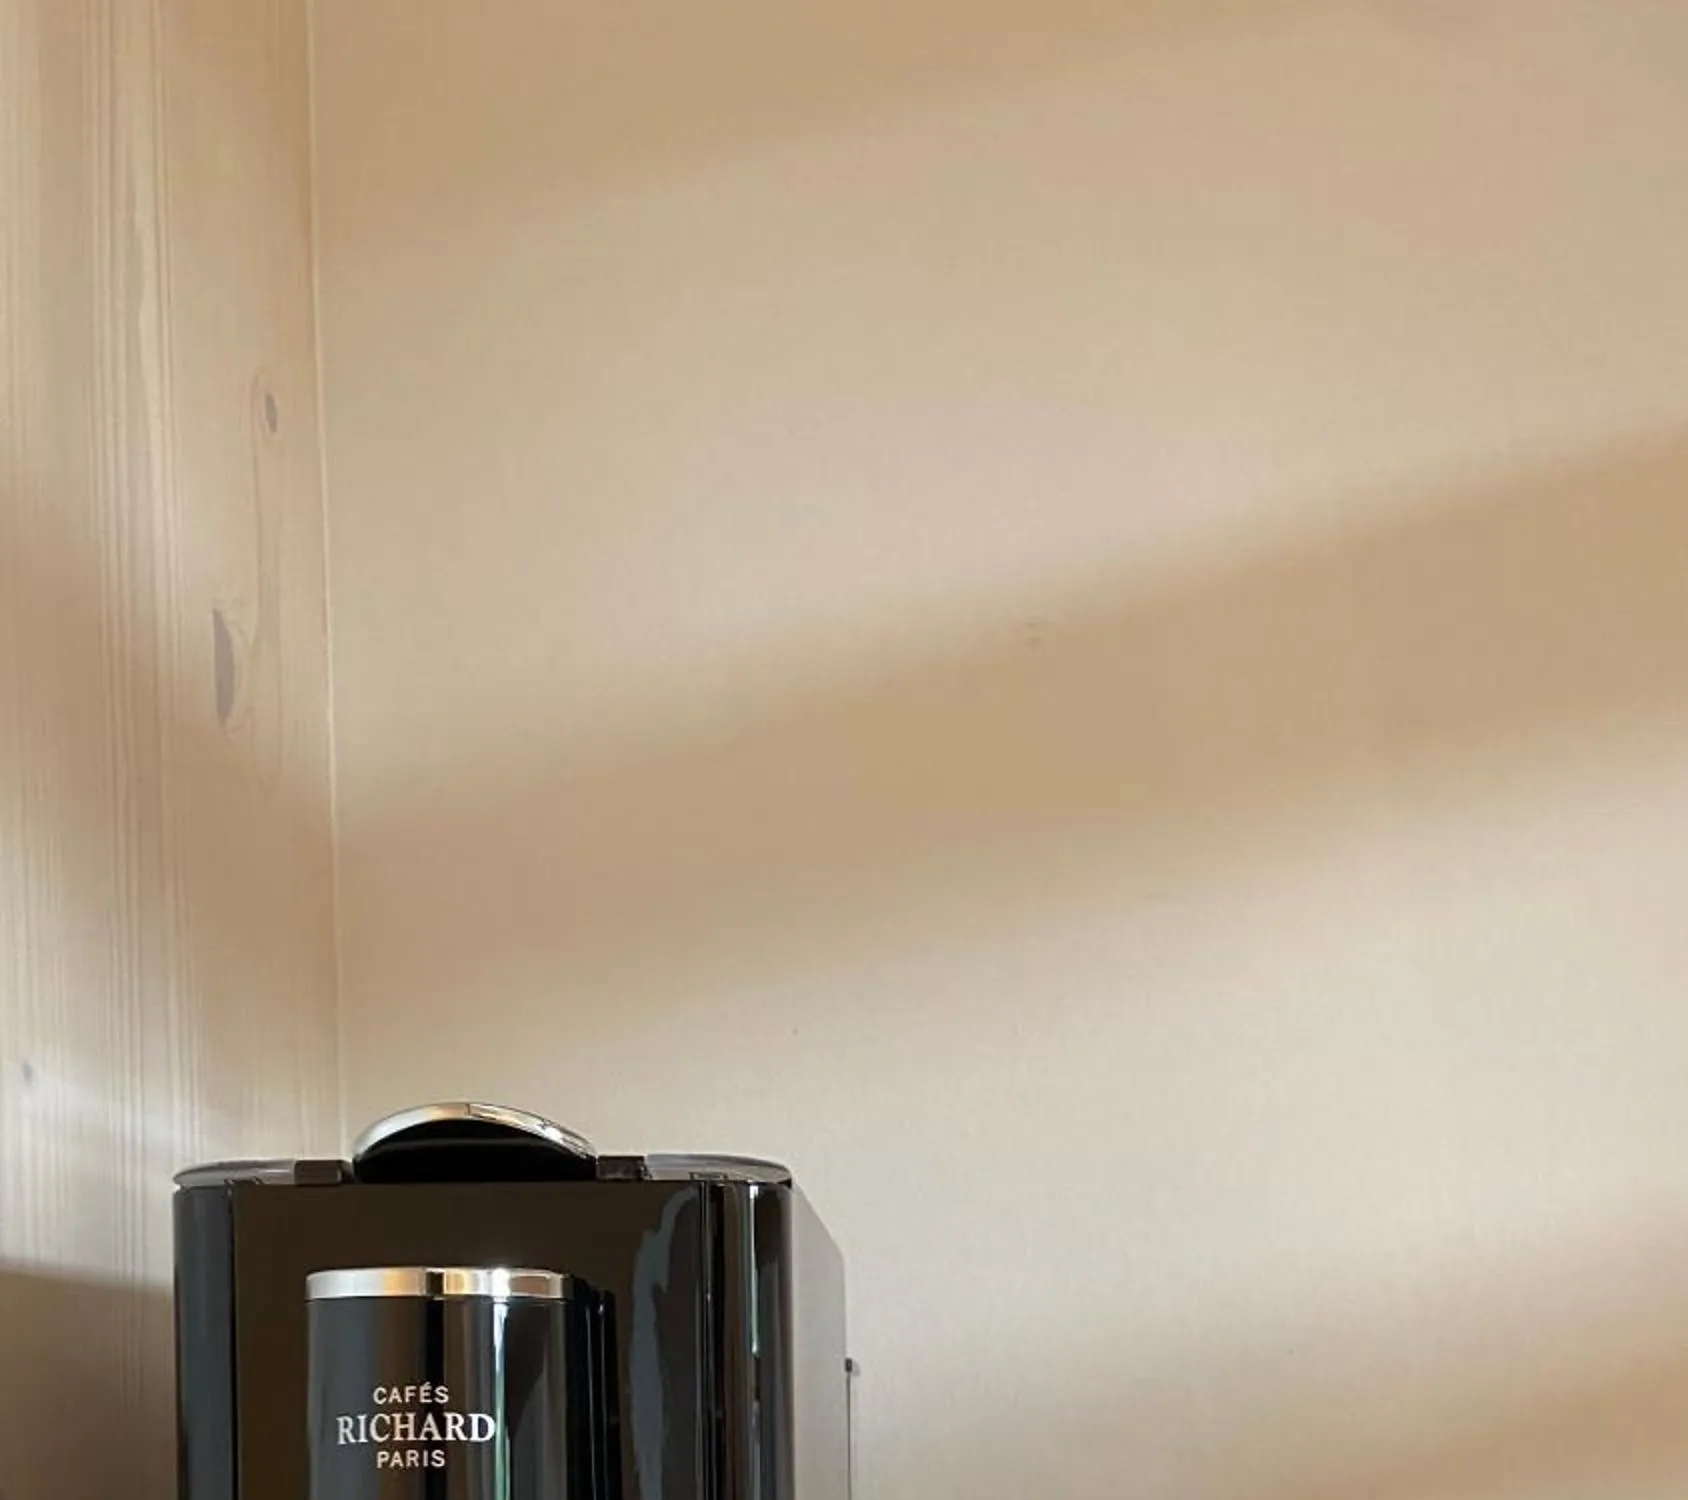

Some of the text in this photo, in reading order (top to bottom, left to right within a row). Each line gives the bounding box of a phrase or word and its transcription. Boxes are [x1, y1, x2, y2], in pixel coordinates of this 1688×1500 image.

[373, 1382, 449, 1404] CAFÉS
[336, 1412, 496, 1445] RICHARD
[376, 1449, 446, 1469] PARIS
